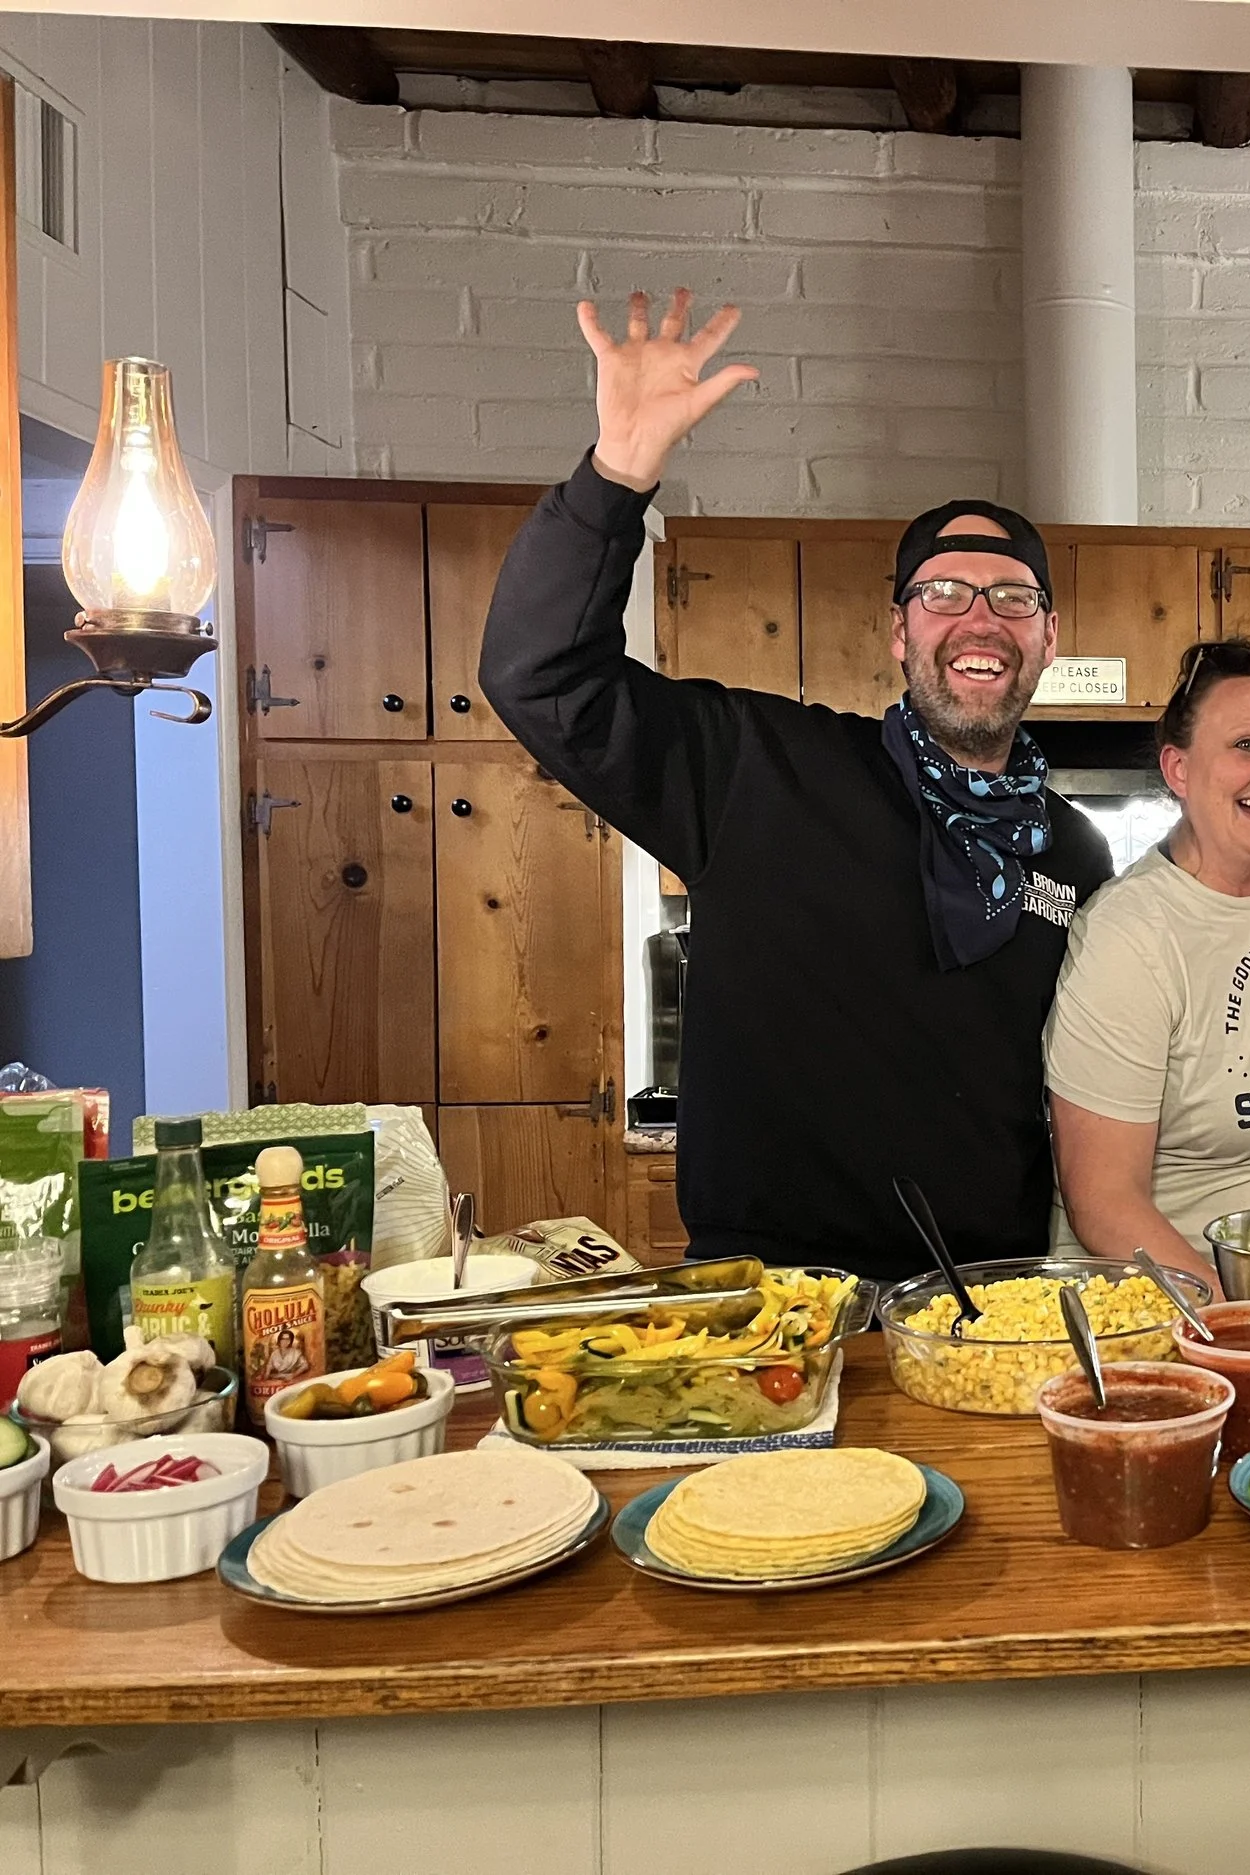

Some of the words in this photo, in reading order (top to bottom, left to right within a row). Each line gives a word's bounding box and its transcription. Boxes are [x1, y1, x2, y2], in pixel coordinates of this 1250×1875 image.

[1052, 666, 1099, 677] PLEASE
[1038, 682, 1065, 693] EEP
[1069, 682, 1118, 693] CLOSED
[1032, 871, 1076, 902] BROWN
[1225, 993, 1242, 1035] THE
[247, 1298, 317, 1336] CHOLULA
[262, 1324, 284, 1336] HOT
[286, 1316, 314, 1329] SAUCE
